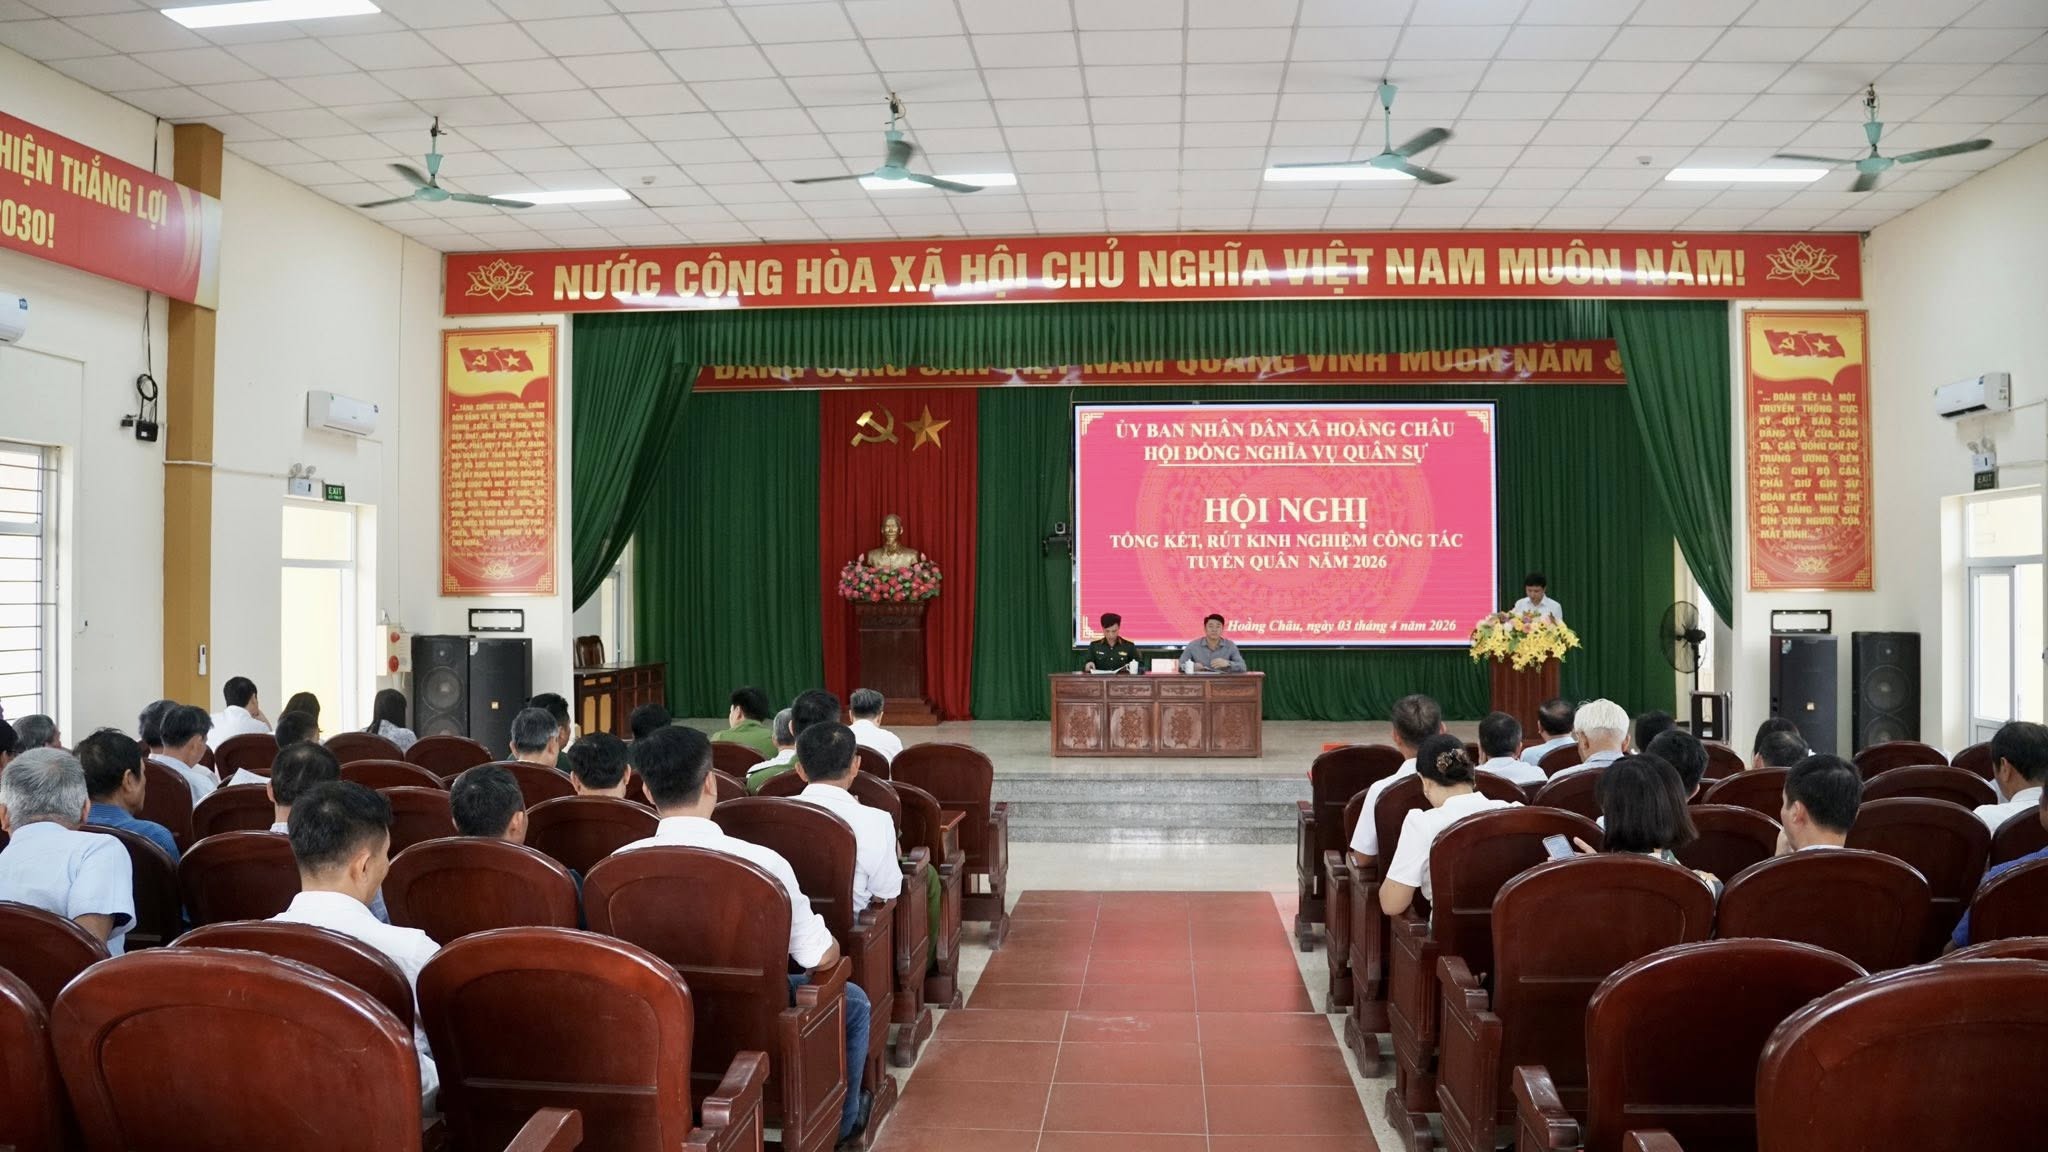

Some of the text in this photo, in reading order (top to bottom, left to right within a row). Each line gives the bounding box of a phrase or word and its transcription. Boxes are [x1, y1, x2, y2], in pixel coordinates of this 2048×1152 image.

[0, 130, 167, 230] HIỆN THẮNG LỢI
[0, 199, 54, 248] 030!
[553, 238, 1745, 303] NƯỚC CỘNG HÒA XÃ HỘI CHỦ NGHĨA VIỆT NAM MUÔN NĂM!
[1514, 344, 1592, 373] NĂM
[1116, 420, 1142, 438] ỦY
[1147, 423, 1185, 438] BAN
[1191, 418, 1244, 438] NHÂN
[1251, 418, 1289, 438] DÂN
[1295, 419, 1321, 437] XÃ
[1401, 418, 1454, 437] CHÂU
[1144, 440, 1429, 464] HỘI ĐỒNG NGHĨA VỤ QUÂN SỰ
[1977, 474, 1993, 483] EXIT
[328, 486, 343, 495] EXIT
[1204, 493, 1367, 530] HỘI NGHỊ
[1208, 530, 1243, 548] RÚT
[1247, 533, 1291, 548] KINH
[1297, 532, 1368, 550] NGHIỆM
[1373, 530, 1422, 548] CÔNG
[1428, 530, 1463, 548] TÁC
[1250, 551, 1300, 571] QUÂN
[1309, 552, 1349, 569] NĂM
[1353, 554, 1388, 569] 2026
[1269, 619, 1304, 633] Châu,
[1306, 620, 1335, 634] ngày
[1337, 620, 1351, 632] 03
[1354, 620, 1387, 634] tháng
[1390, 620, 1398, 632] 4
[1400, 620, 1427, 632] năm
[1429, 620, 1457, 632] 2026
